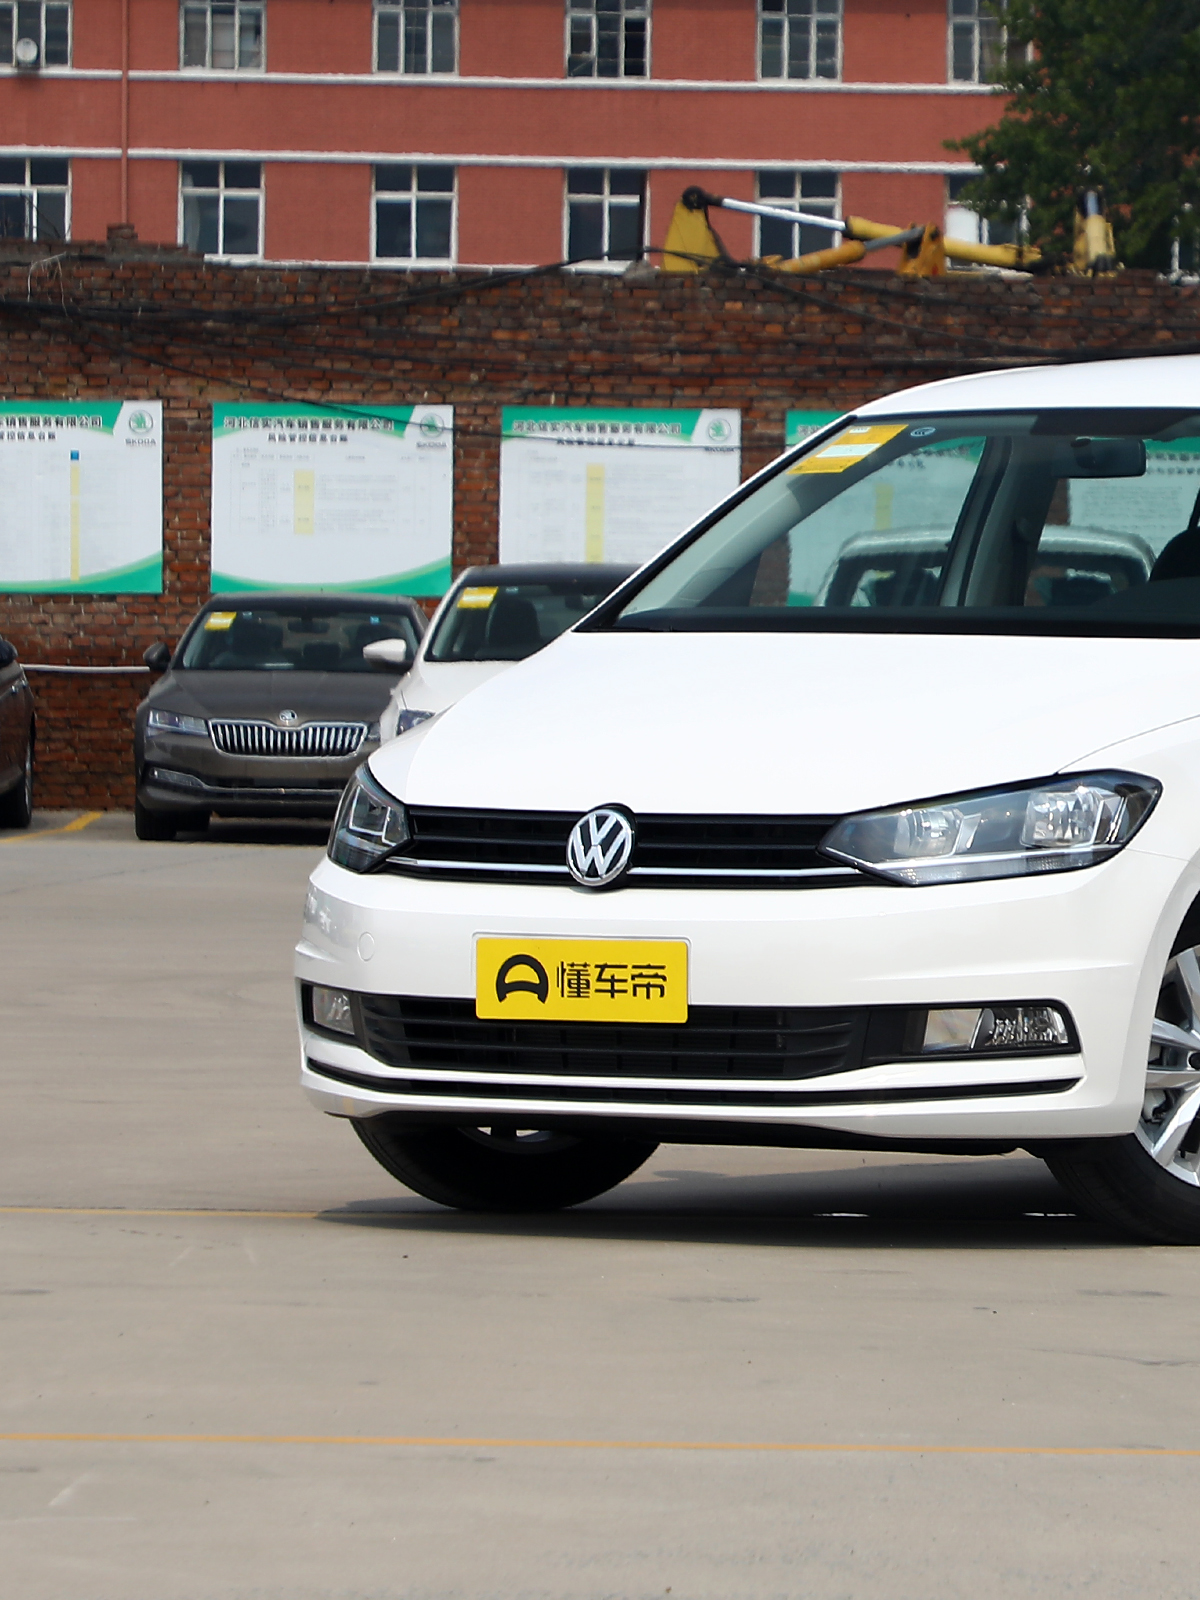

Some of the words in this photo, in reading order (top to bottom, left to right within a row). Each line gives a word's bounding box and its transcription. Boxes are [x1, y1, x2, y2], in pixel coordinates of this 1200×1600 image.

[568, 810, 631, 884] VW
[557, 961, 667, 1000] 懂车帝
